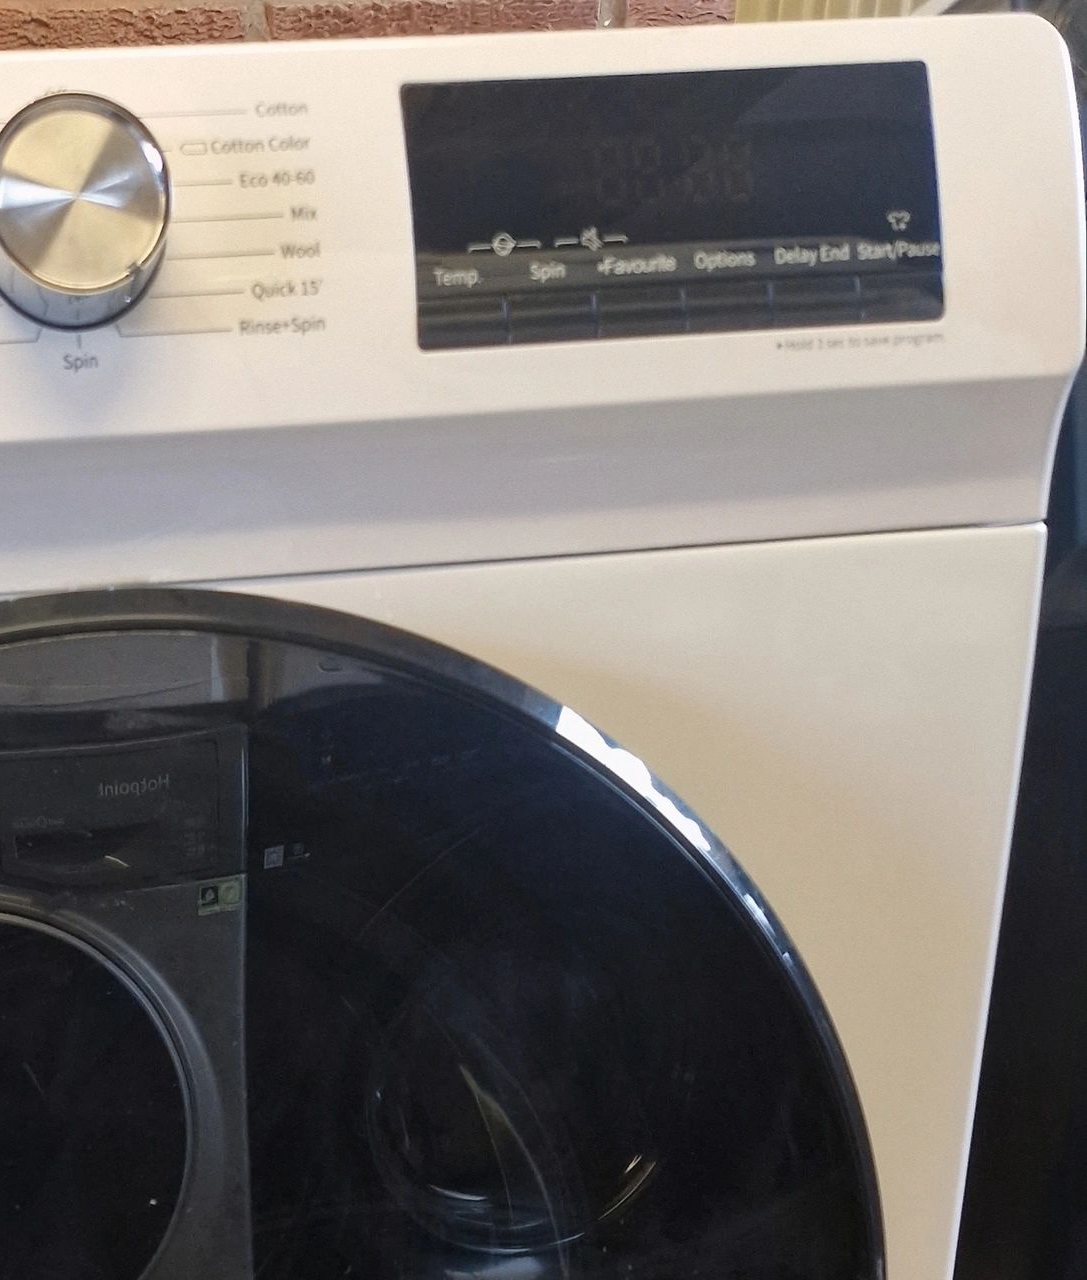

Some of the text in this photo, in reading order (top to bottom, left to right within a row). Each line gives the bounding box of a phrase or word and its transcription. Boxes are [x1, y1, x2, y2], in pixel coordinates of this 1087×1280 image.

[255, 102, 309, 118] Cotton
[211, 135, 311, 155] Cotton Color
[239, 169, 315, 188] Eco 40-60
[290, 206, 317, 221] Mix
[280, 243, 321, 260] Wool
[693, 251, 756, 272] Options
[774, 243, 851, 267] Delay End
[529, 261, 567, 284] Spin
[251, 280, 296, 302] Quick
[239, 316, 326, 337] Rinse+Spin
[63, 354, 99, 373] Spin
